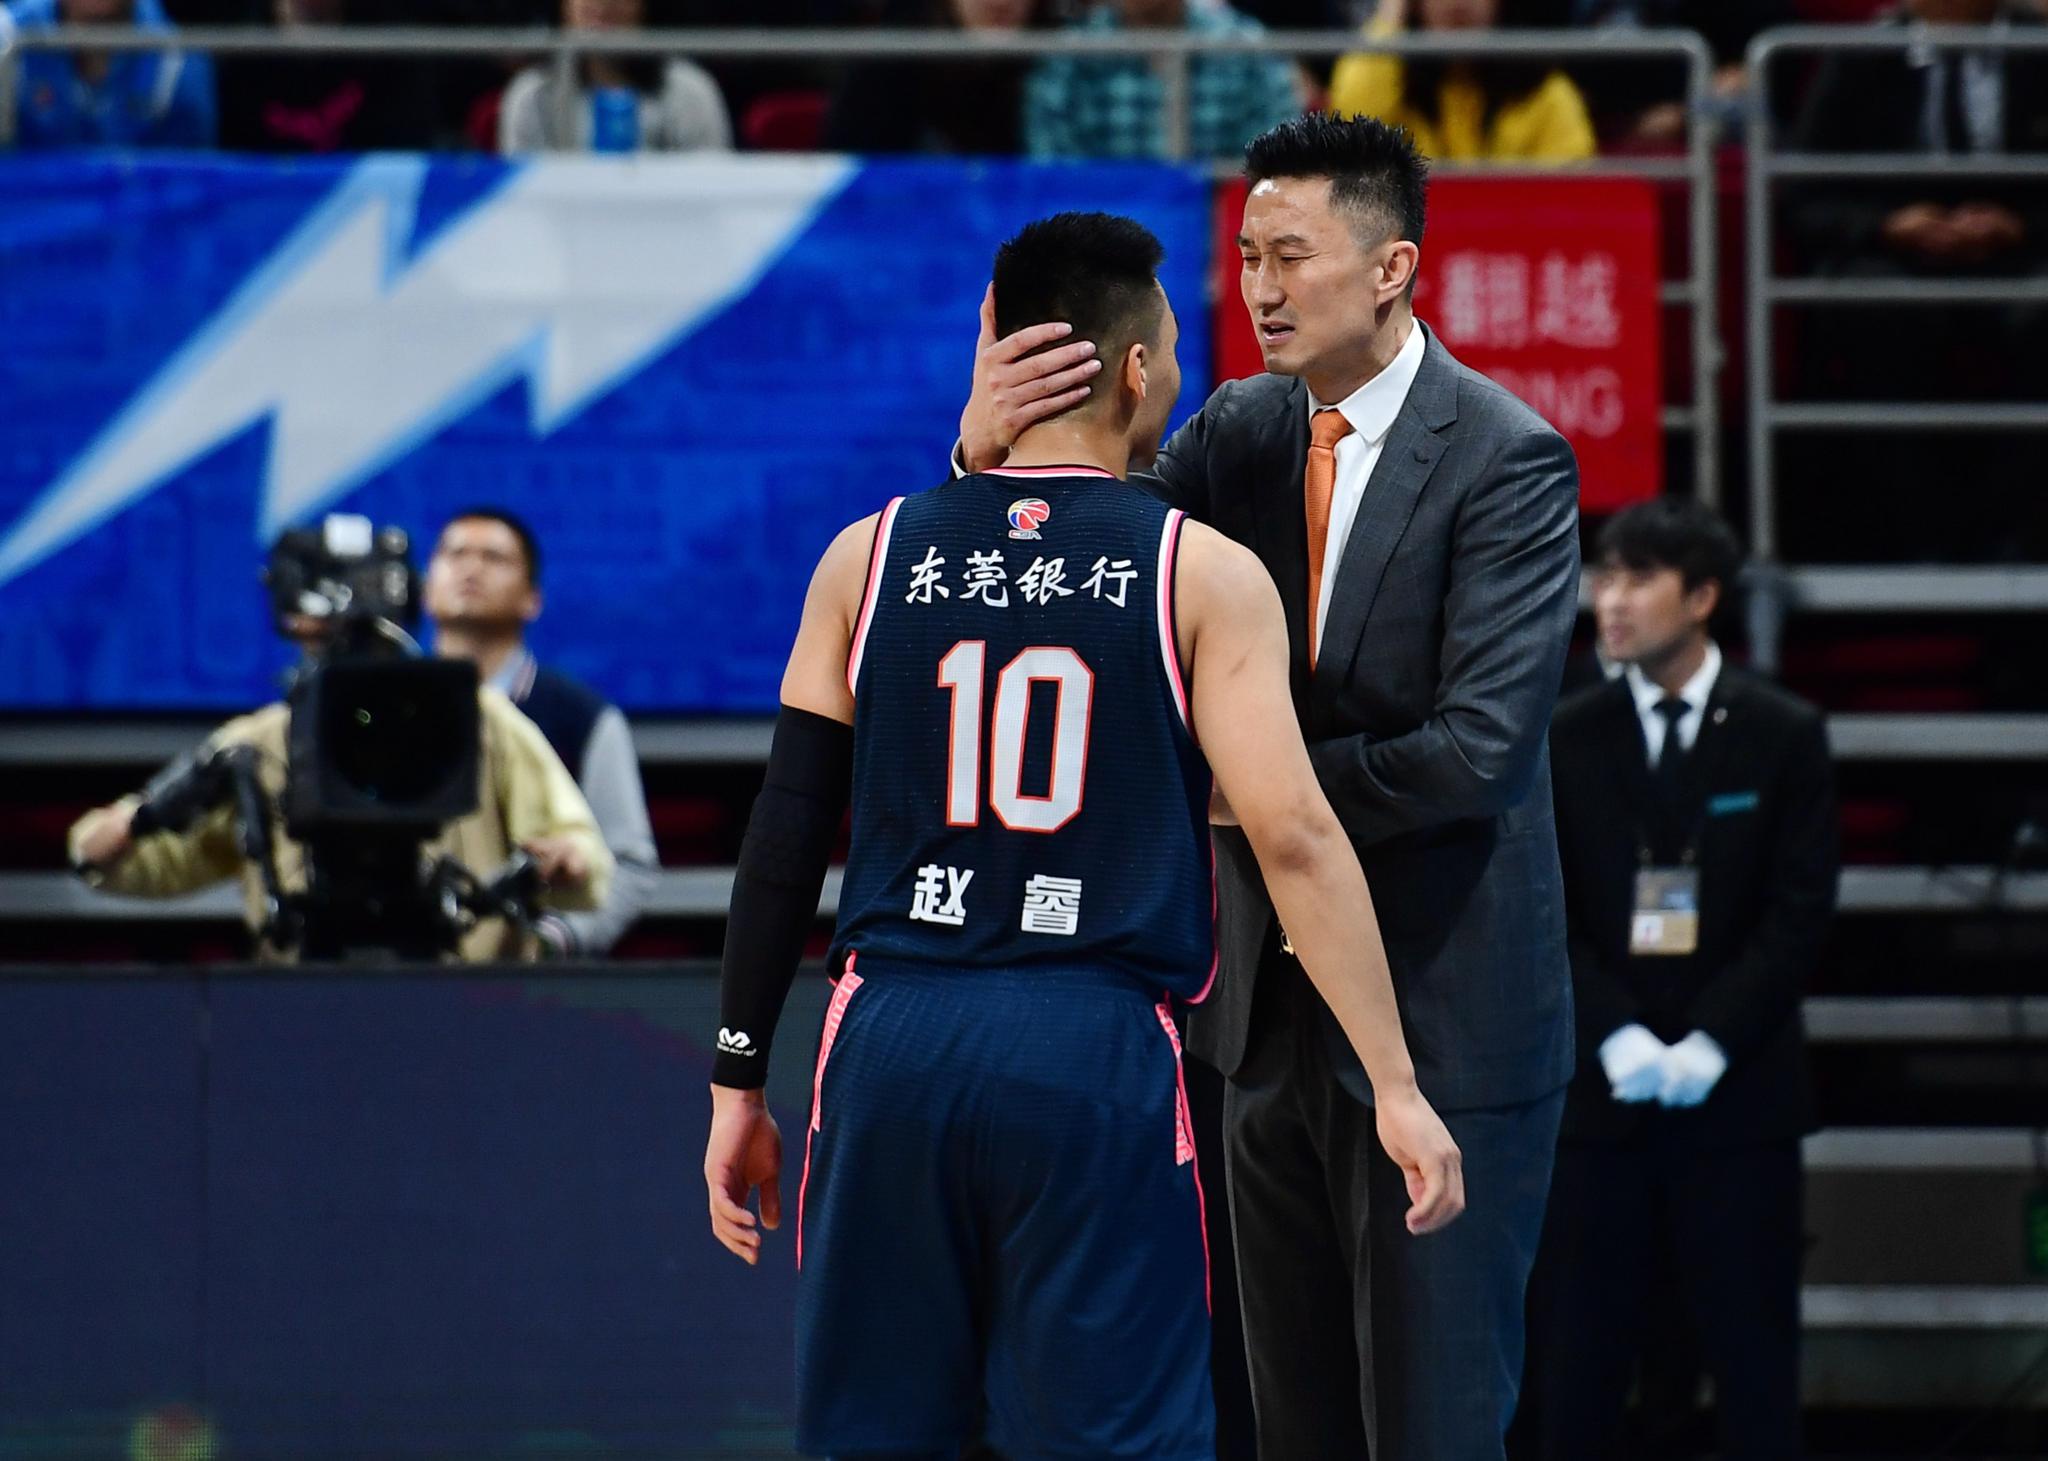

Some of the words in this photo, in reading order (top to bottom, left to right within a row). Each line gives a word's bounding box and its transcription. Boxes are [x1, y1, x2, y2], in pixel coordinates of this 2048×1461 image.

[1414, 250, 1622, 348] 翻越
[905, 545, 1139, 608] 东莞银行
[938, 640, 1095, 833] 10
